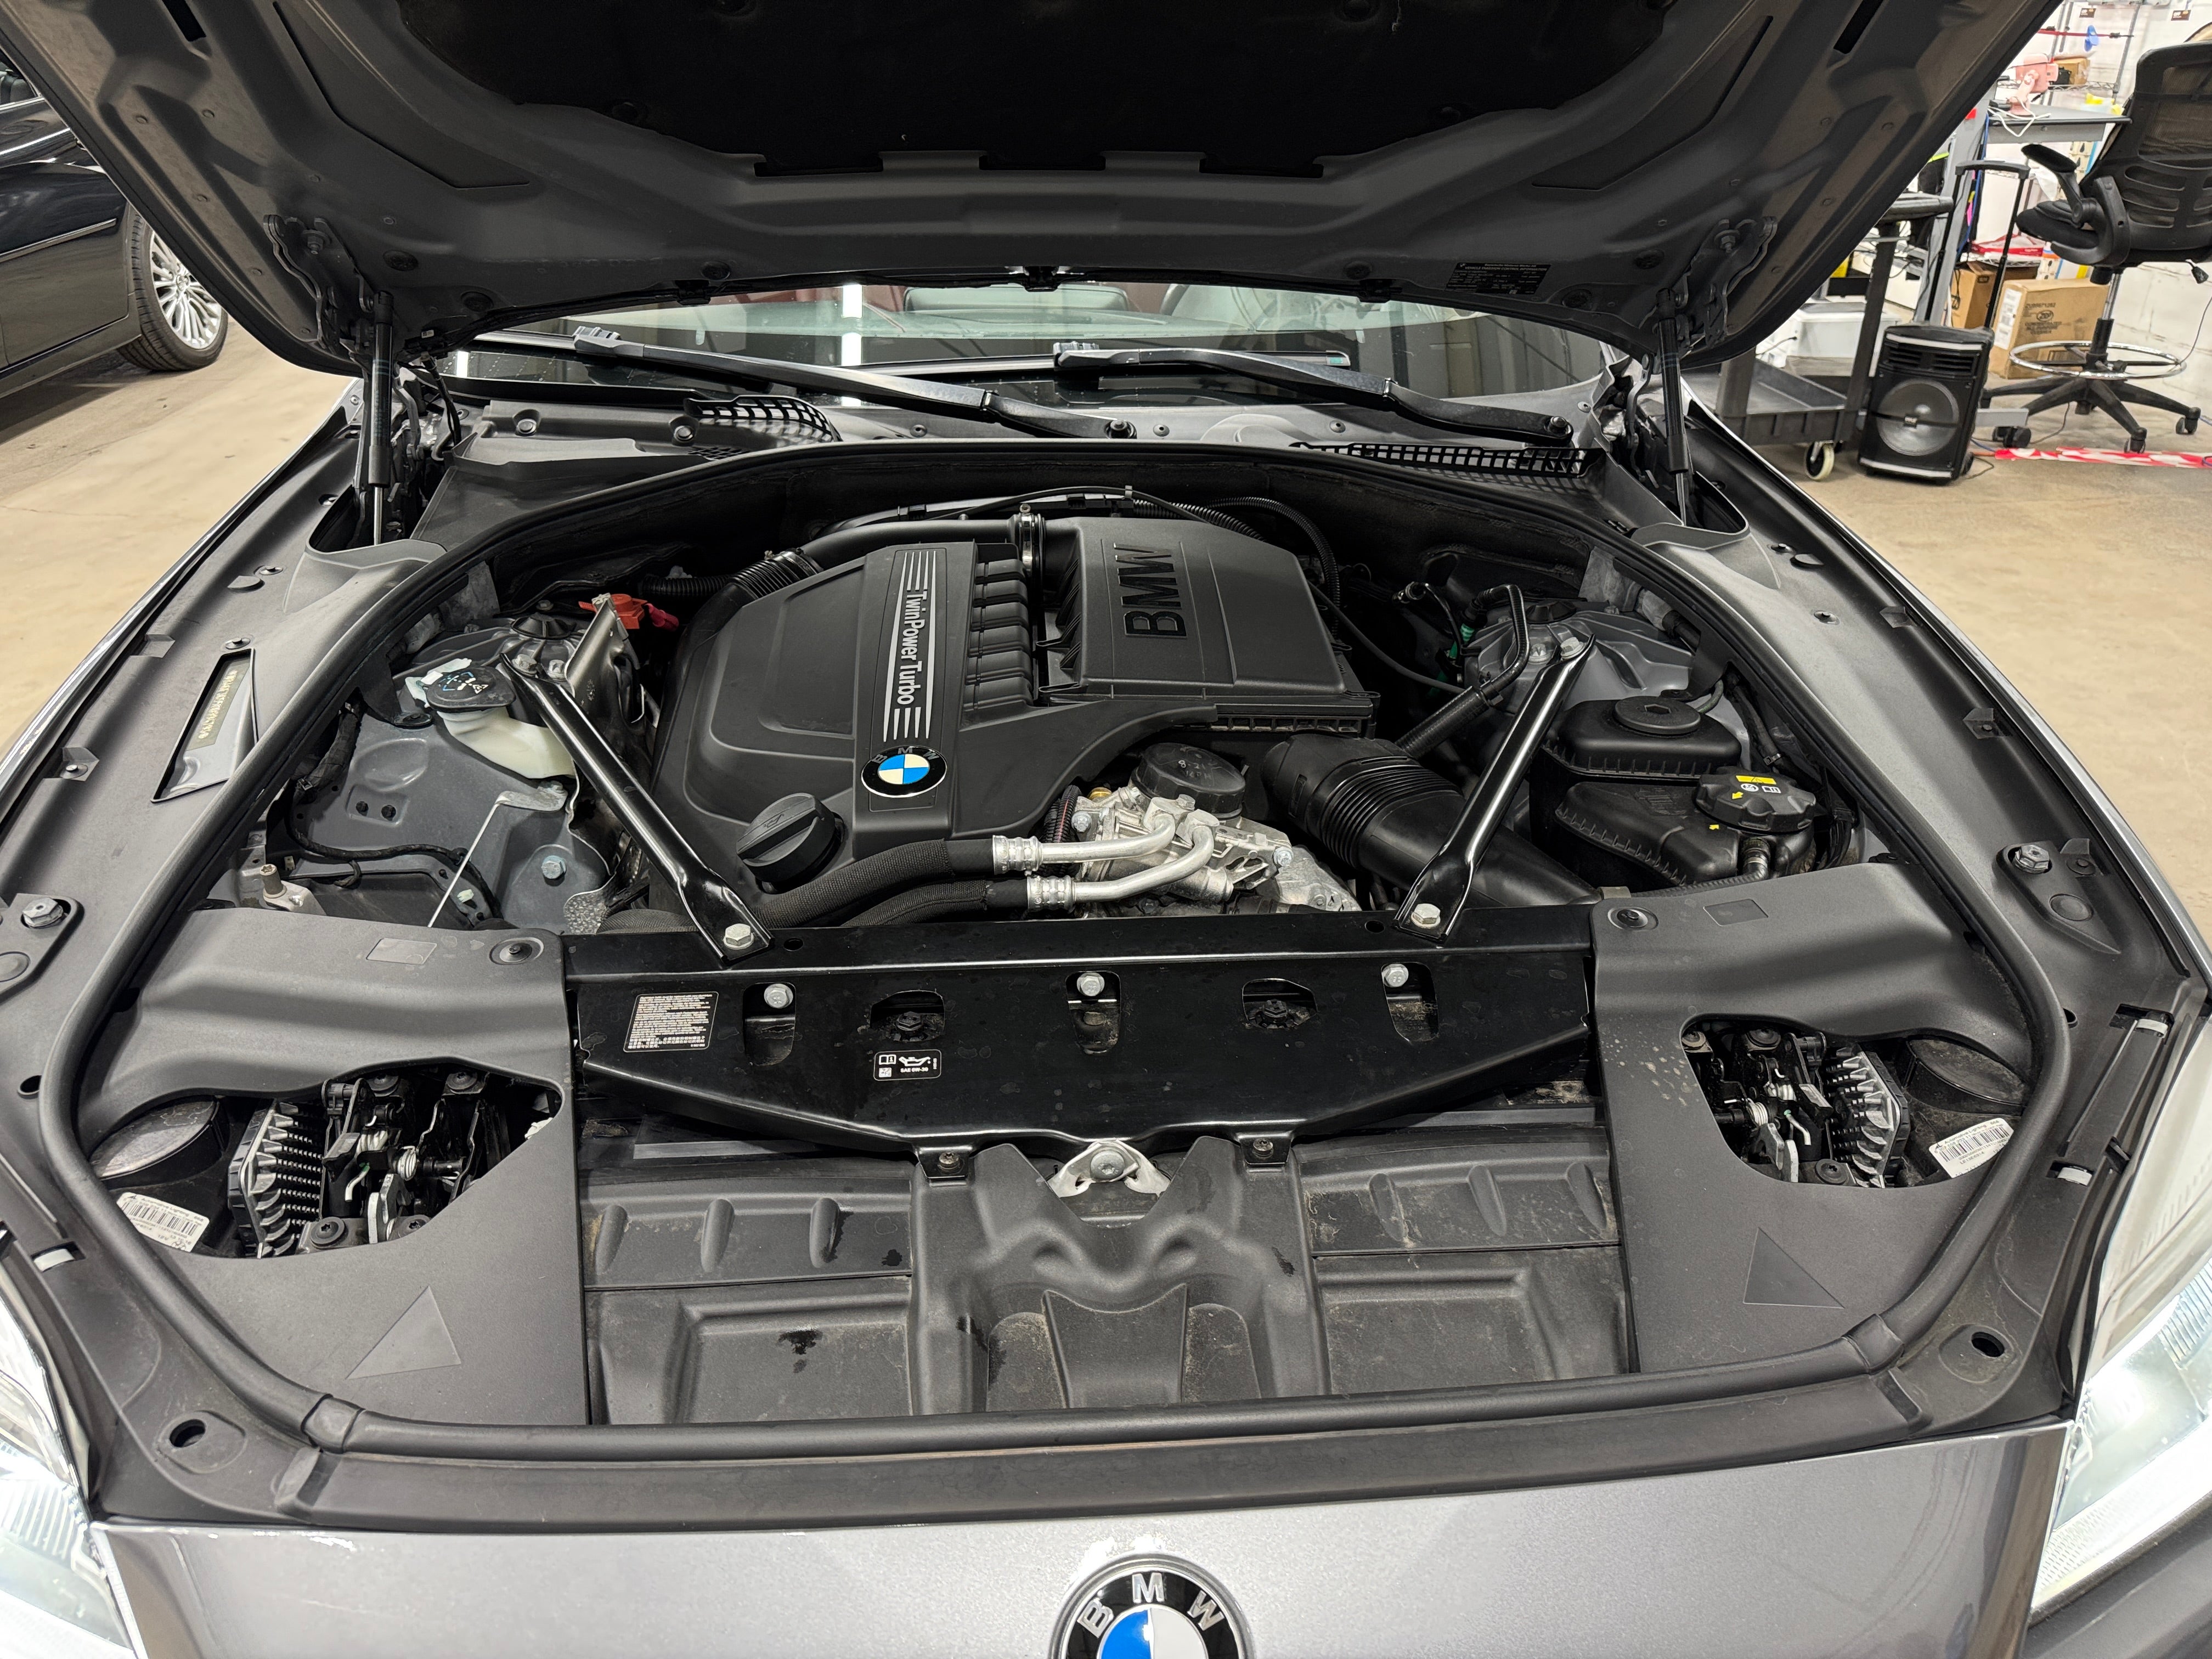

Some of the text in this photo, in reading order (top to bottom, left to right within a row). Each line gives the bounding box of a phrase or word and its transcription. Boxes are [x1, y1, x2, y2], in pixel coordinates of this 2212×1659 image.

[1114, 542, 1187, 639] BMW
[897, 591, 927, 705] TwinPower Turbo
[871, 747, 940, 764] BMW
[1077, 1572, 1225, 1639] BMW
